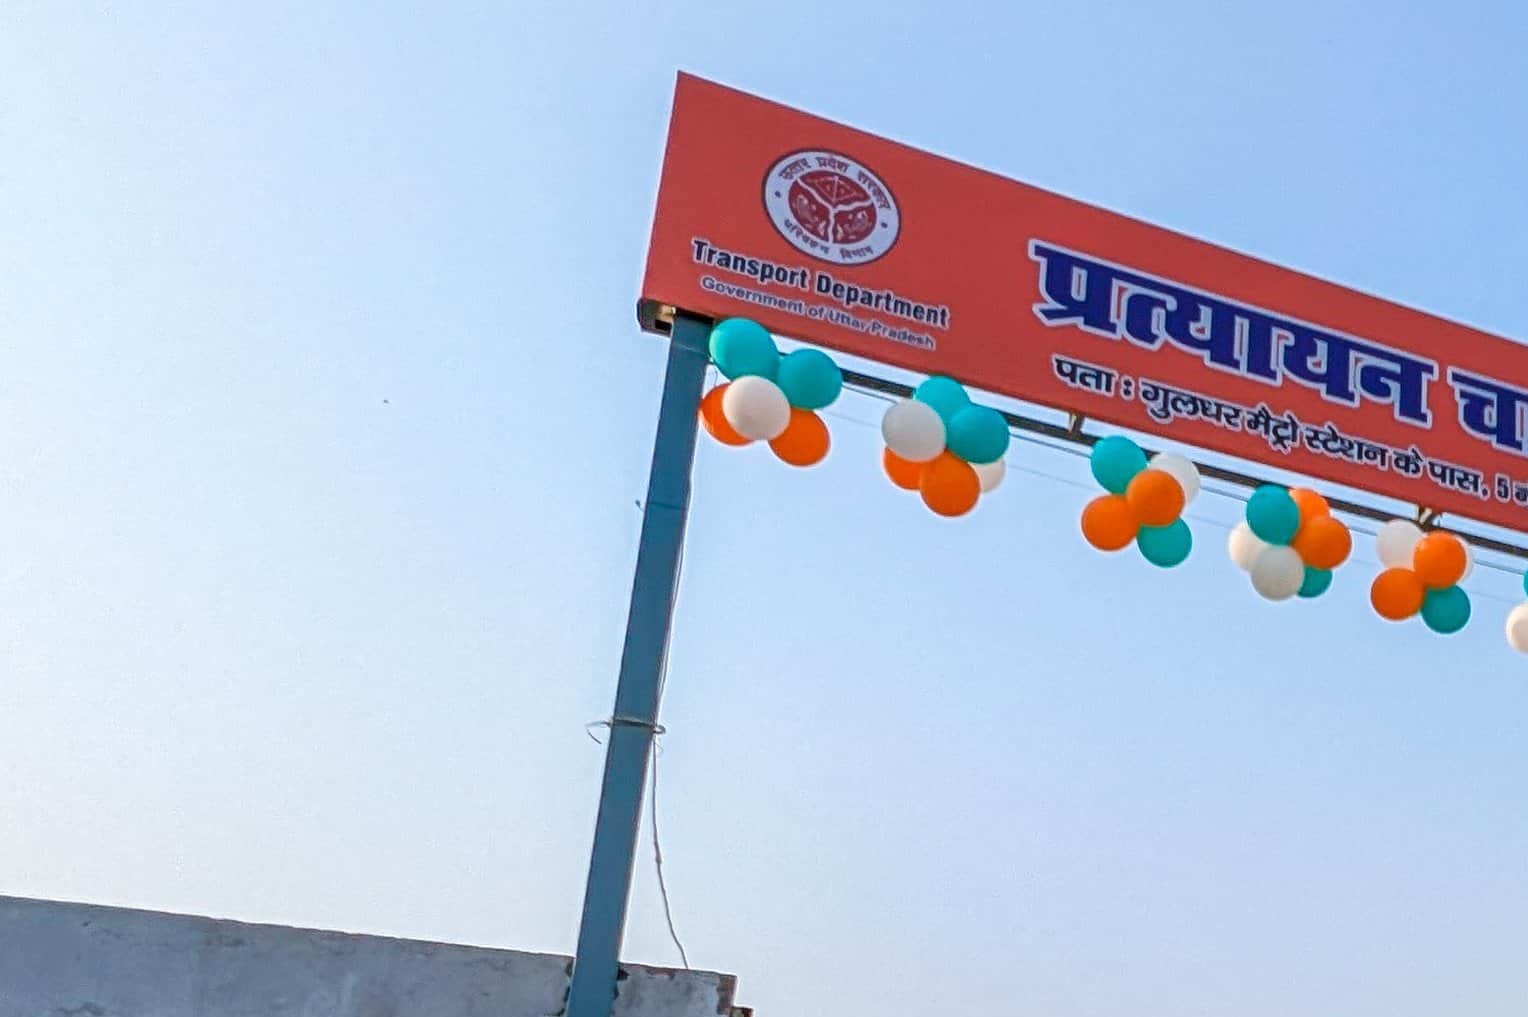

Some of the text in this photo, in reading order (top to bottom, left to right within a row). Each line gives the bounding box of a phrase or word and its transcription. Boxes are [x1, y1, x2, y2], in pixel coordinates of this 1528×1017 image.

[692, 239, 950, 328] Transport Department
[701, 275, 936, 350] Government of Uttar Pradesh
[1030, 242, 1436, 426] प्रत्यायन
[1054, 356, 1116, 396] पता
[1140, 380, 1243, 423] गुलधर
[1303, 424, 1388, 470] स्टेशन
[1394, 447, 1424, 479] के
[1495, 476, 1510, 502] 5
